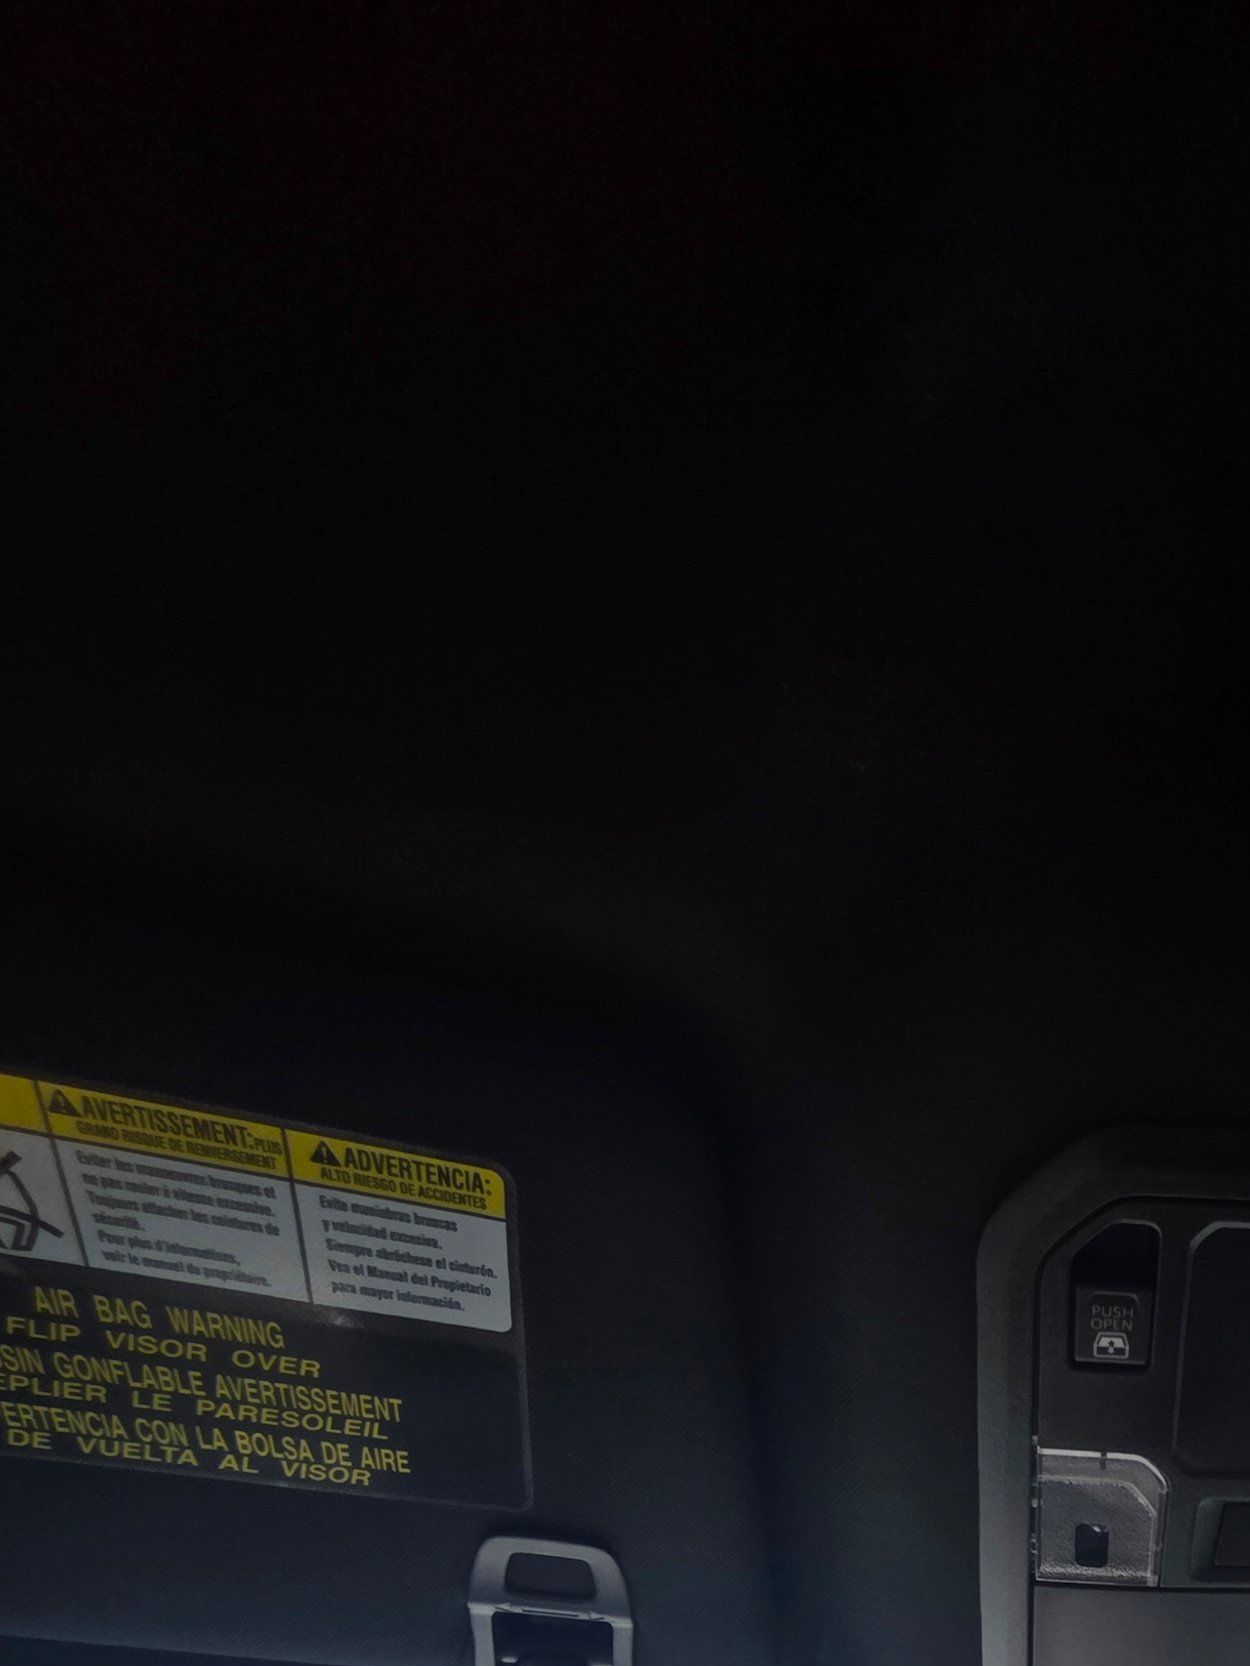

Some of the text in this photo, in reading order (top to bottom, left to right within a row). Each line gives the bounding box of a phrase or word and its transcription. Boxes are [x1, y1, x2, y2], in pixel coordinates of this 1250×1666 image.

[320, 1167, 487, 1210] ALTO RIESGO DE ACCIDENTES
[344, 1147, 492, 1196] ADVERTENCIA:
[33, 1285, 285, 1349] AIR BAG WARNING
[1090, 1318, 1133, 1331] OPEN
[1091, 1304, 1135, 1318] PUSH
[6, 1315, 321, 1379] FLIP VISOR OVER
[53, 1351, 207, 1397] GONFLABLE
[216, 1374, 403, 1423] AVERTISSEMENT
[131, 1390, 172, 1412] LE
[196, 1399, 389, 1440] PARESOLEIL
[8, 1428, 372, 1487] DE VUELTA AL VISOR
[134, 1418, 190, 1448] CON
[195, 1425, 229, 1451] LA
[235, 1429, 314, 1463] BOLSA
[321, 1440, 353, 1467] DE
[361, 1446, 411, 1474] AIRE
